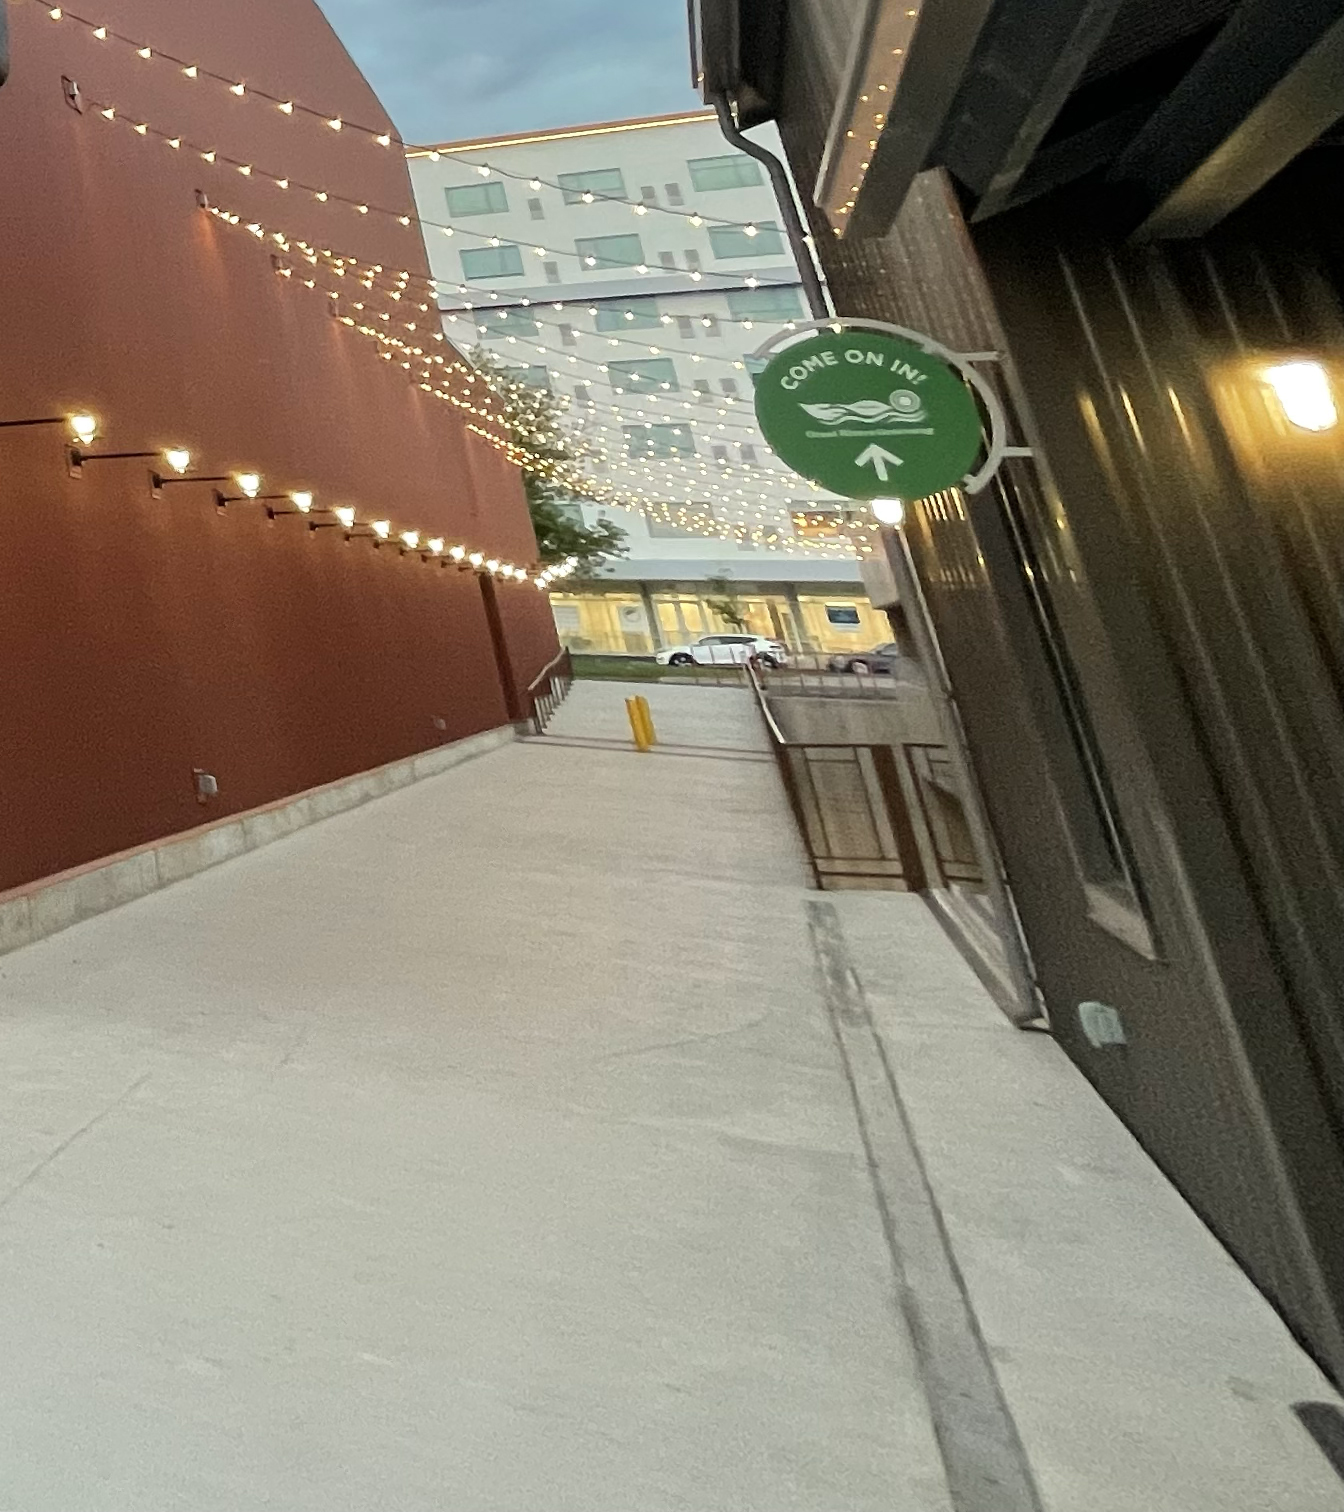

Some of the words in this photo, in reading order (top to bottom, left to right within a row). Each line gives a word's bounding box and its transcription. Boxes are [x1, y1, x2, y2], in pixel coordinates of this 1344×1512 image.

[780, 350, 838, 390] COME
[844, 349, 884, 367] ON
[890, 359, 928, 385] IN!
